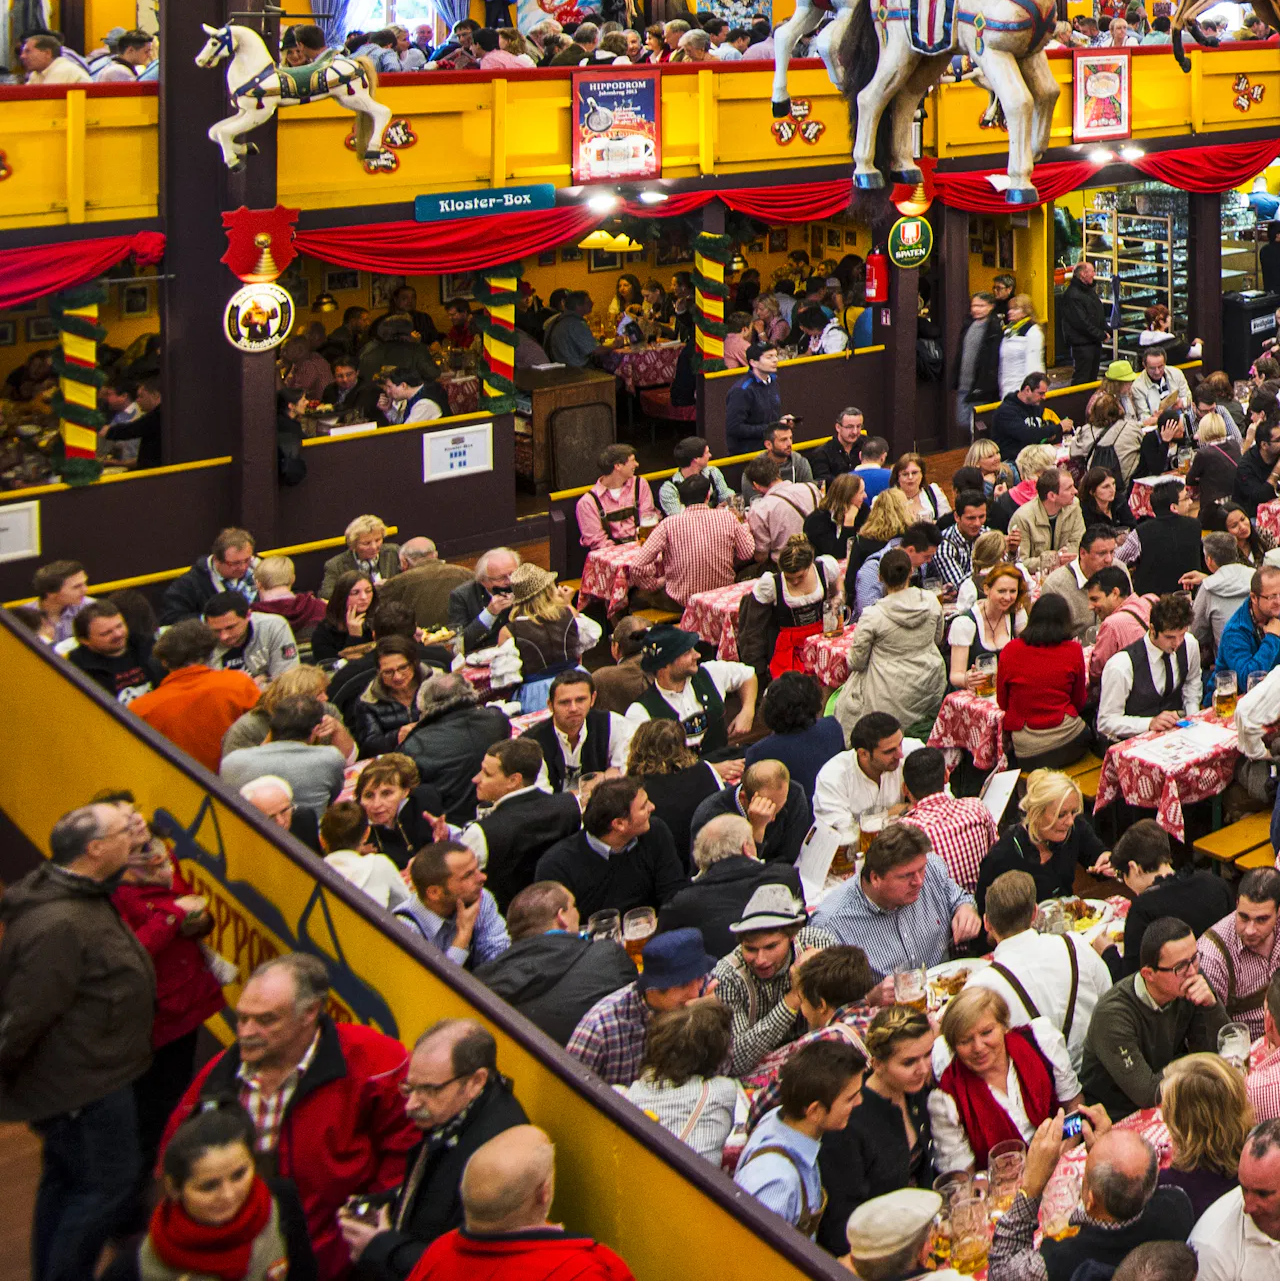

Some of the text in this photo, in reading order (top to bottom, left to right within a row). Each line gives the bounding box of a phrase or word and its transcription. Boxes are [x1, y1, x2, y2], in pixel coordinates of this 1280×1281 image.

[589, 80, 647, 92] HIPPODROM
[438, 193, 532, 213] Kloster-Box
[895, 247, 926, 259] SPATEN
